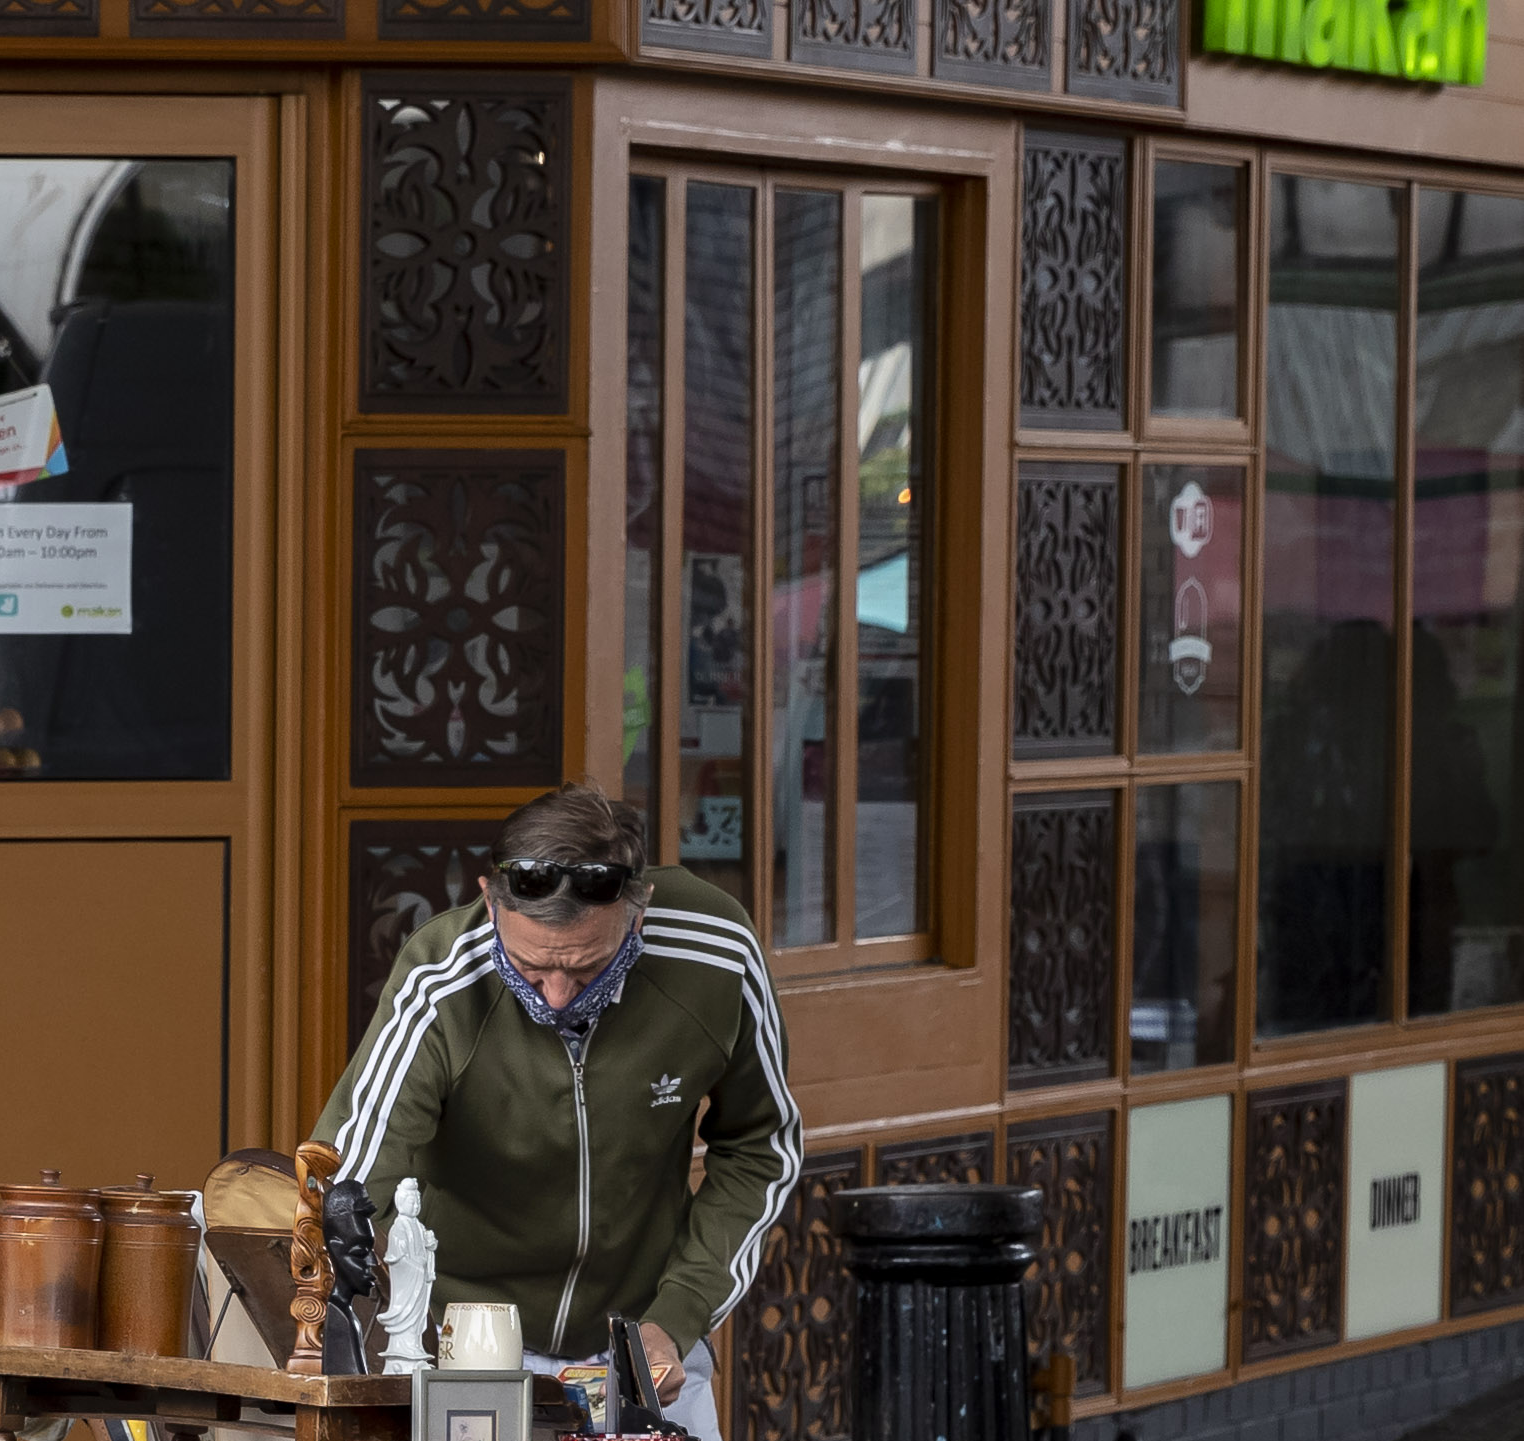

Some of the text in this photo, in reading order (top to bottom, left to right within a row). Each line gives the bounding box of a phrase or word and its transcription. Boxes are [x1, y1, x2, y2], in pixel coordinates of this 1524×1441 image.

[8, 526, 43, 540] Every
[46, 526, 71, 540] Day
[75, 526, 108, 538] From
[41, 546, 97, 560] 10:00pm
[1370, 1172, 1420, 1231] DINNER
[1130, 1205, 1223, 1275] BREAKFAST
